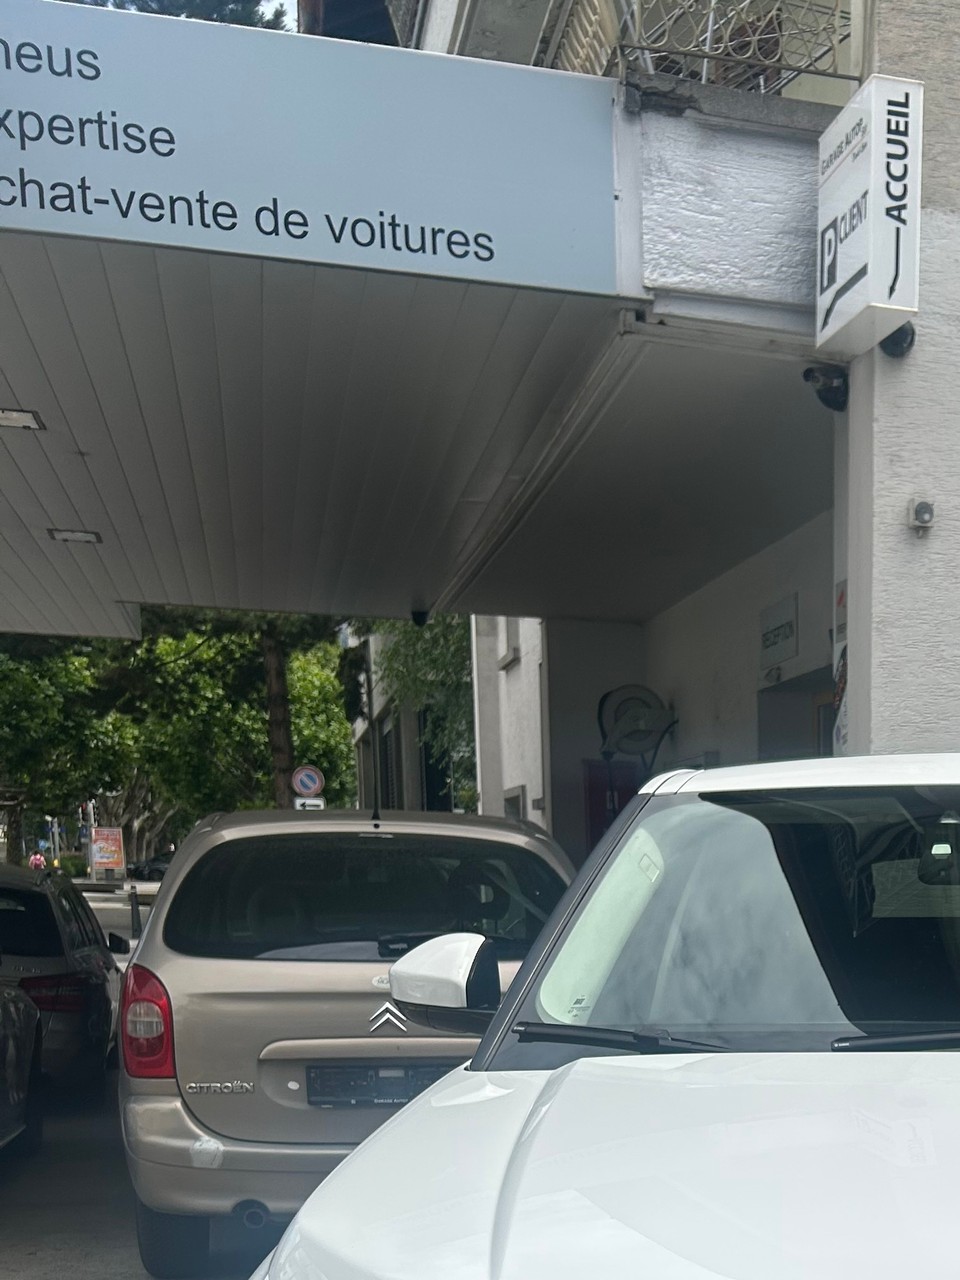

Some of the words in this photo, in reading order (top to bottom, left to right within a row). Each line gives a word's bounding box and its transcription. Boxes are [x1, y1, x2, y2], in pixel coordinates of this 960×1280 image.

[885, 92, 910, 226] ACCUEIL
[254, 197, 309, 240] de
[325, 210, 495, 262] voitures
[838, 189, 869, 245] CLIENT
[186, 1080, 255, 1094] CITROËN
